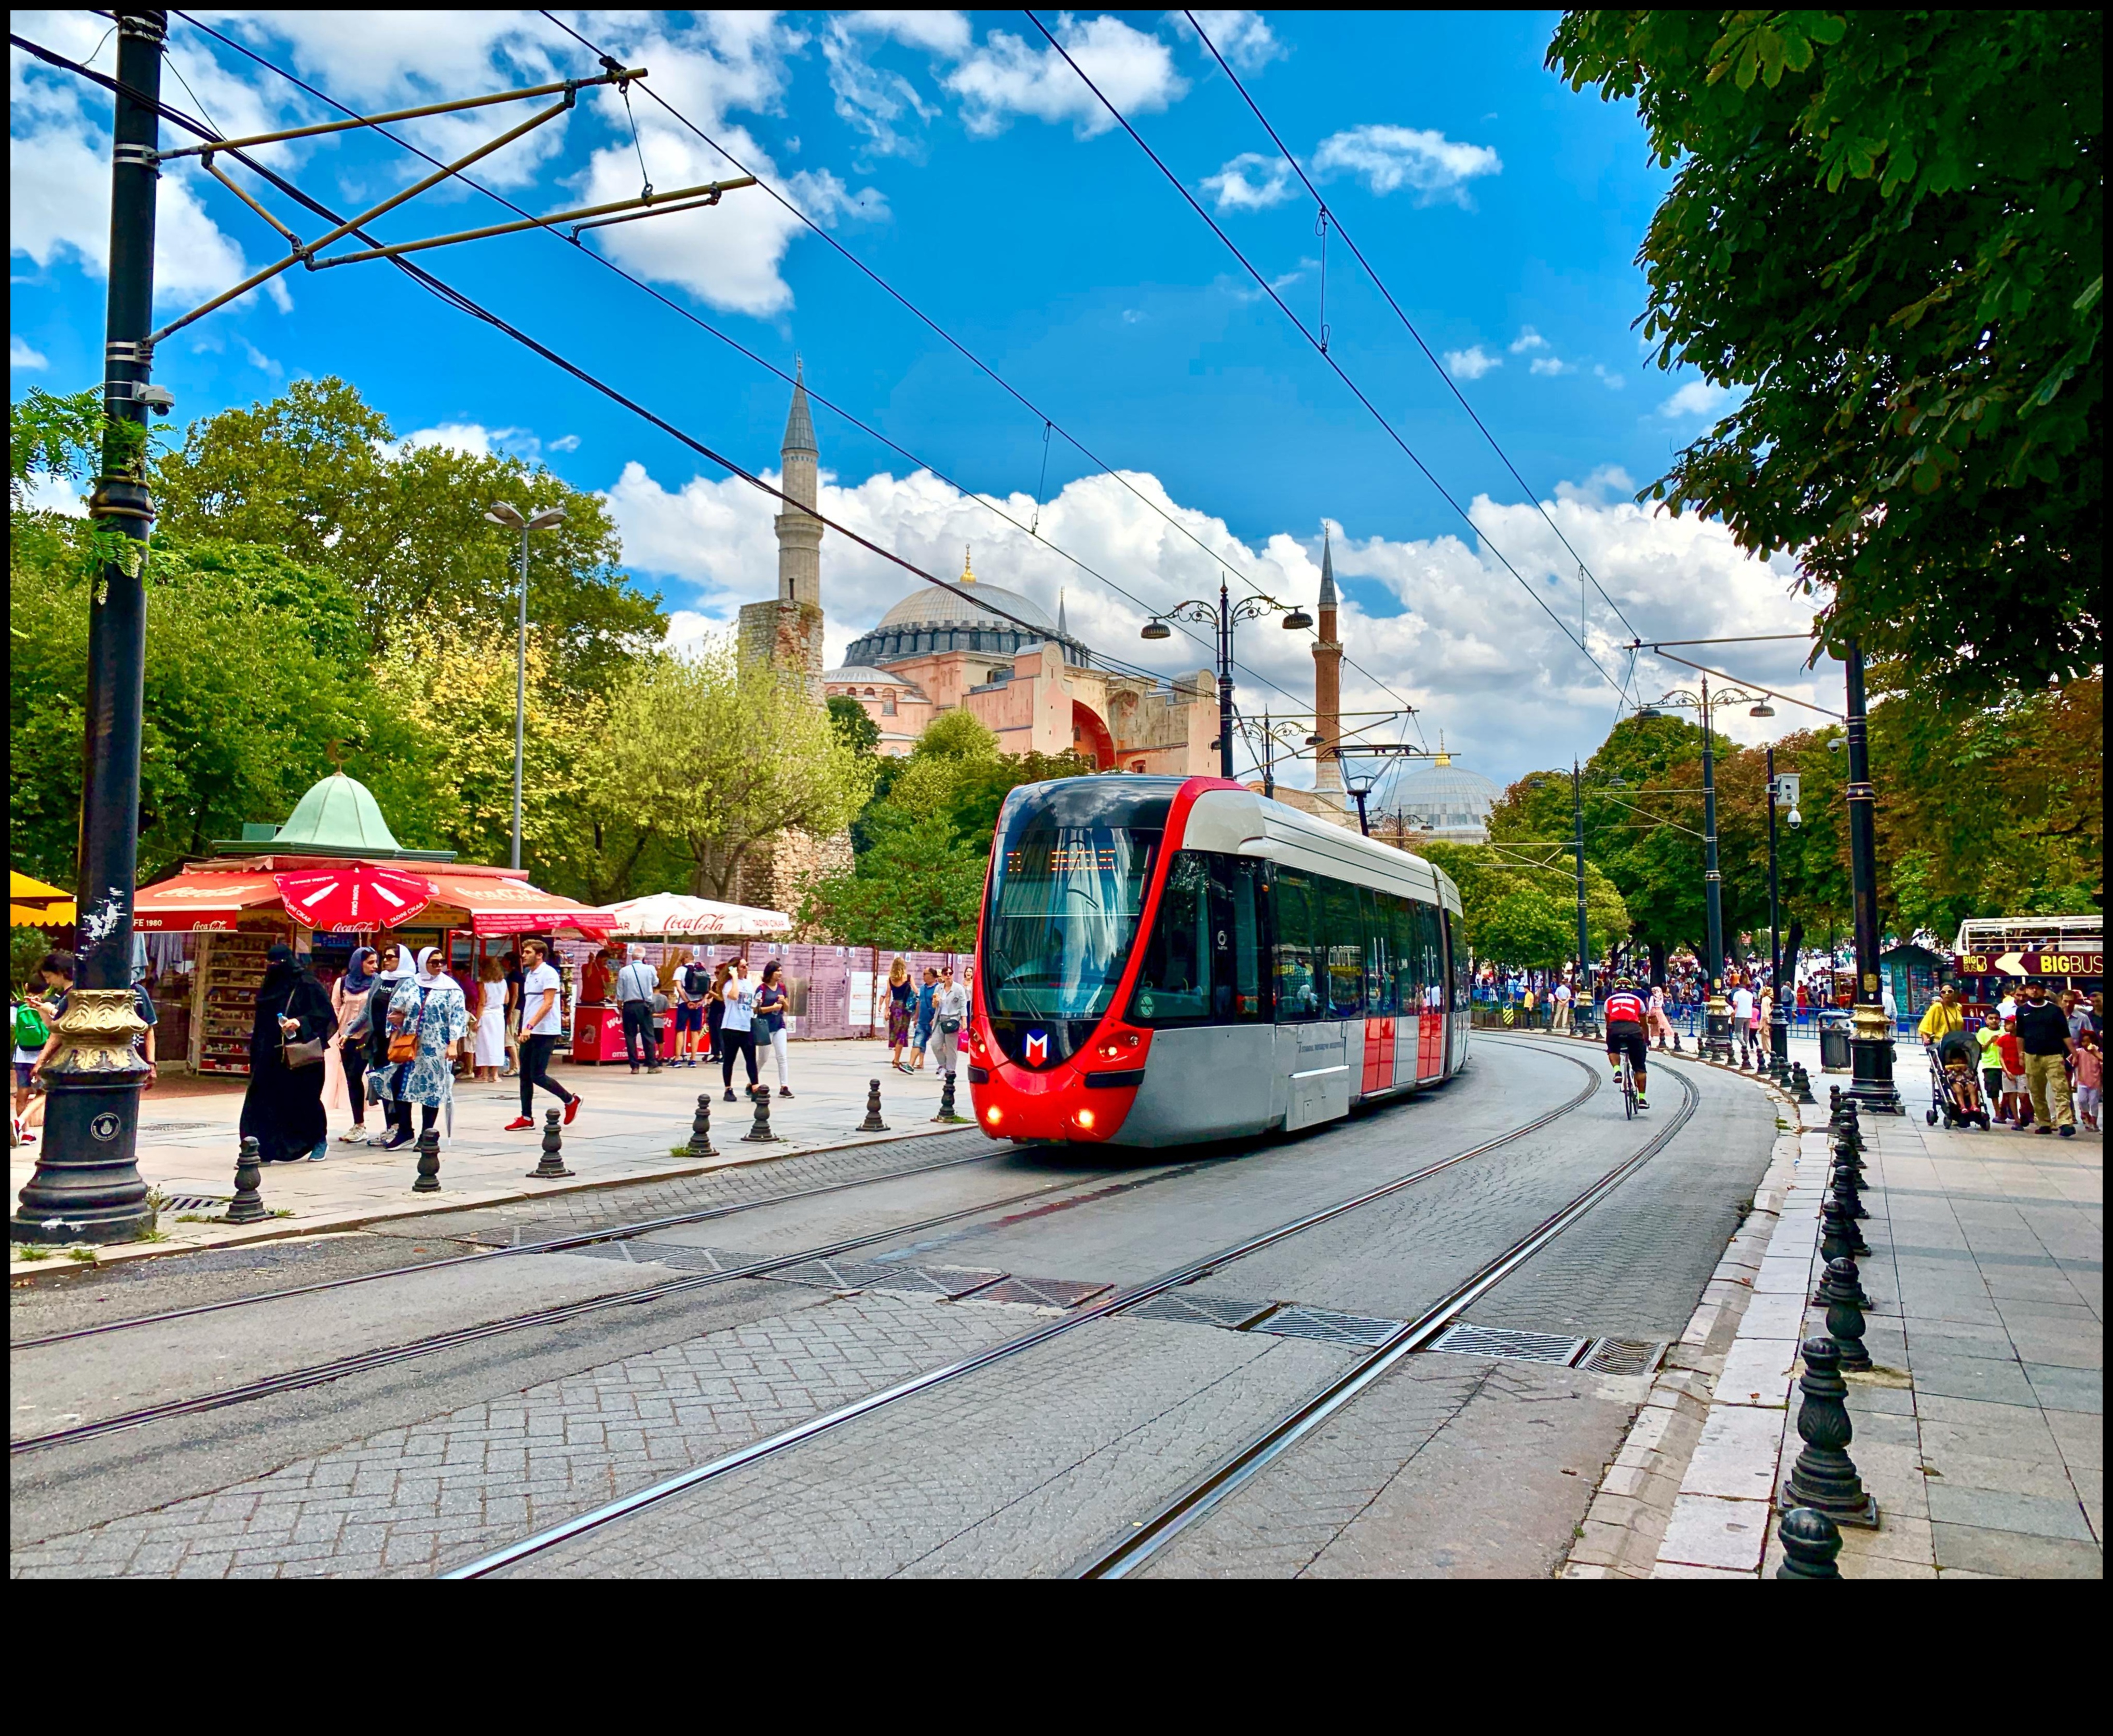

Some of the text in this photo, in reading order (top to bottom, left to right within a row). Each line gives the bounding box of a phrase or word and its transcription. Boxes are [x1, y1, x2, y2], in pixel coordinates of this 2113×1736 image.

[133, 918, 144, 927] FE
[619, 922, 630, 930] AR
[1963, 955, 1976, 965] BIG
[1964, 964, 1977, 972] BUS
